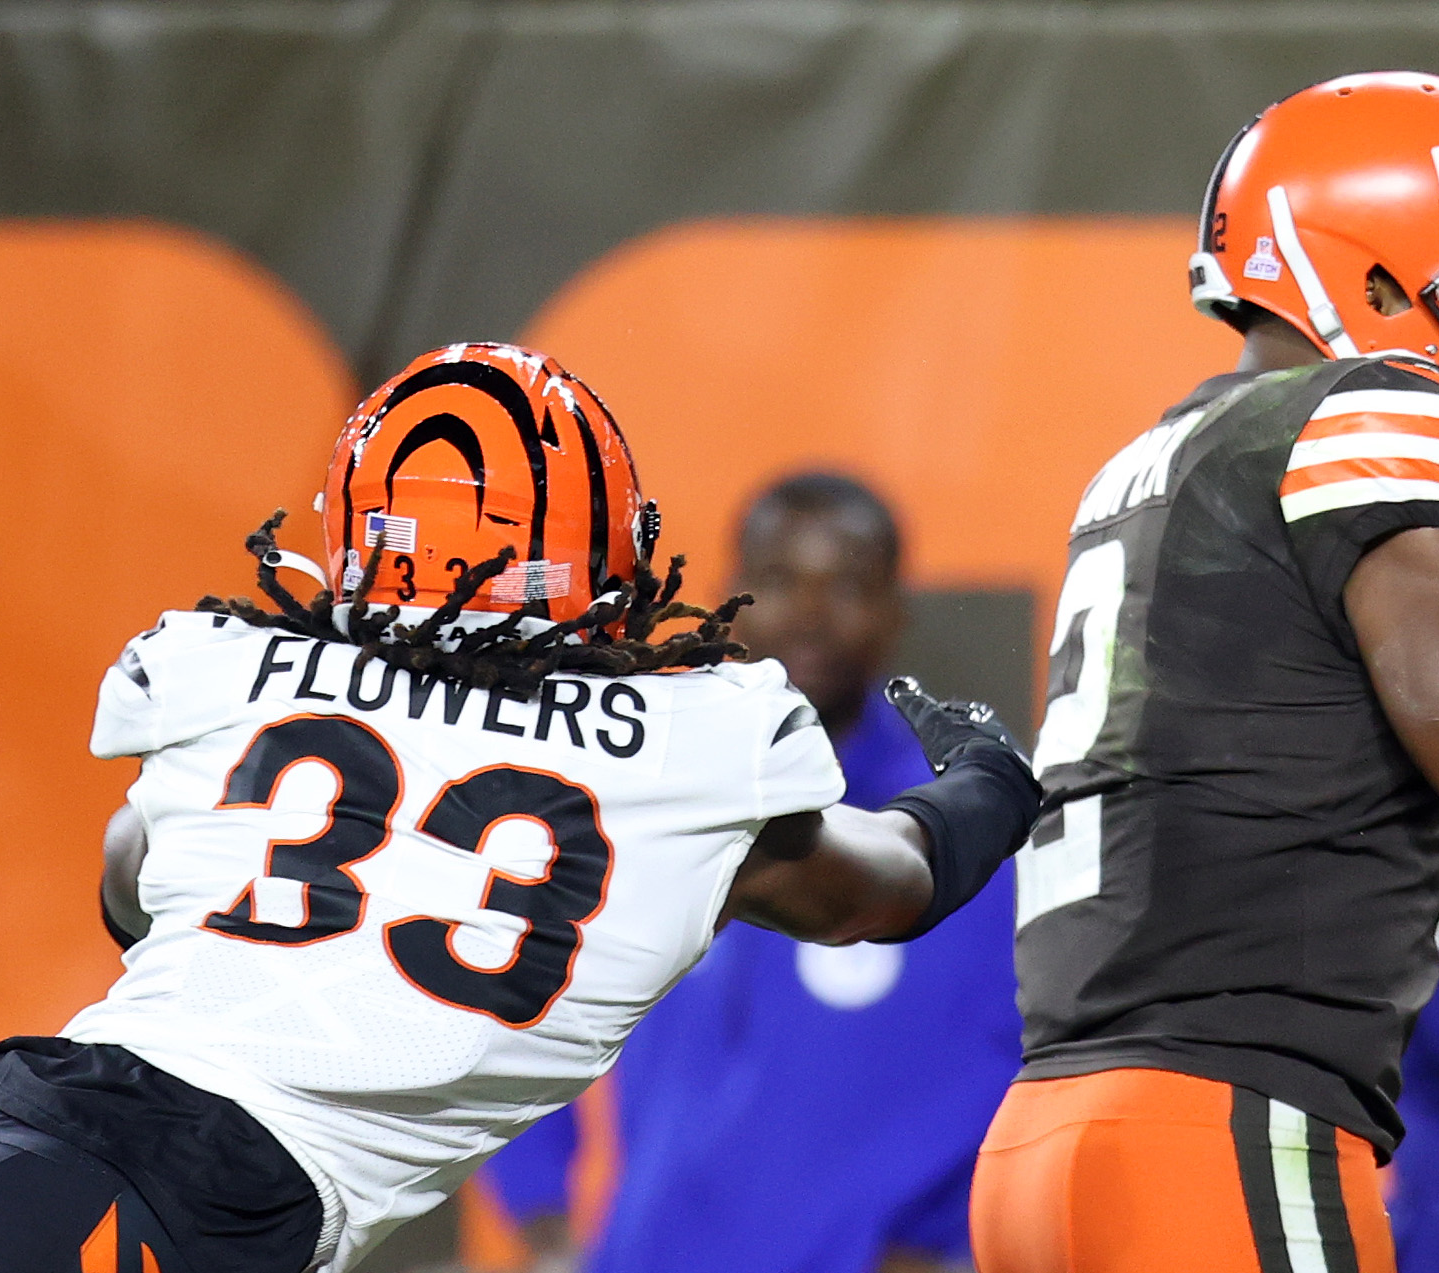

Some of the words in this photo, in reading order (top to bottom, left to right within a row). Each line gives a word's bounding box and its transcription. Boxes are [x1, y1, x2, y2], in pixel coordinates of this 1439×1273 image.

[247, 635, 647, 758] FLOWERS
[1016, 540, 1126, 934] 2
[196, 712, 615, 1030] 33
